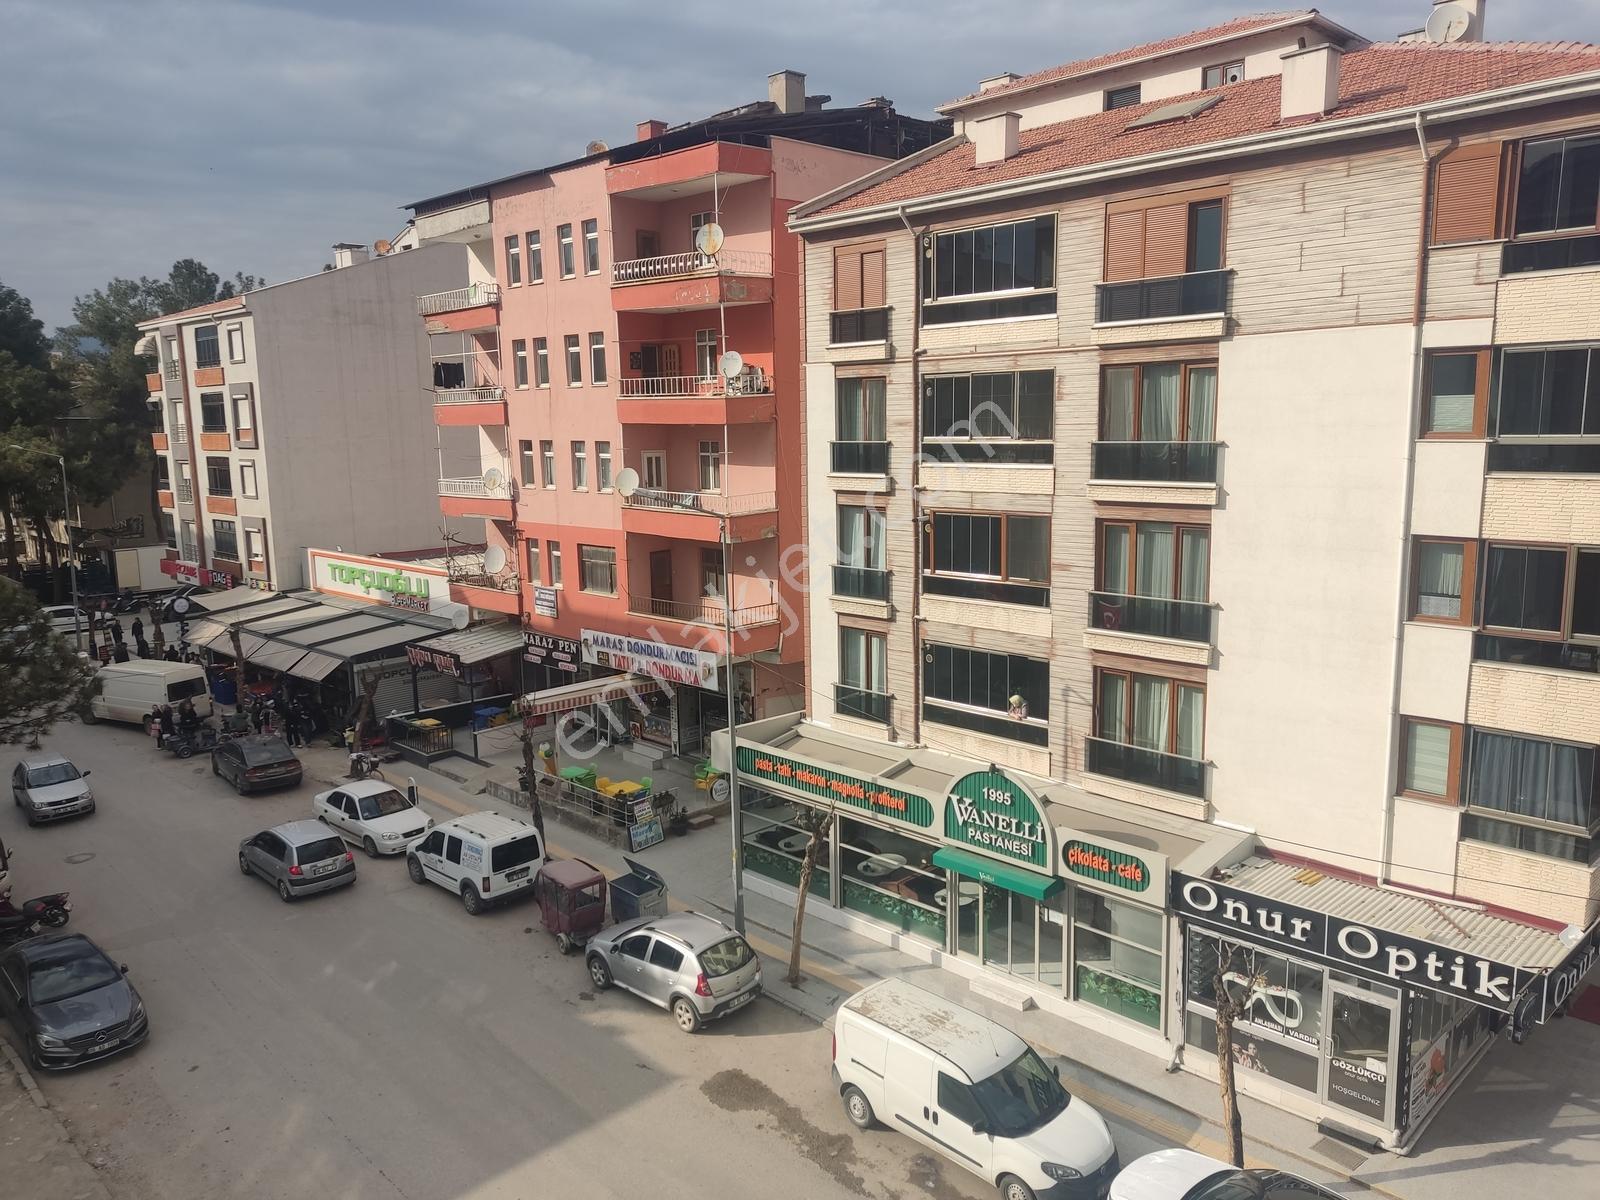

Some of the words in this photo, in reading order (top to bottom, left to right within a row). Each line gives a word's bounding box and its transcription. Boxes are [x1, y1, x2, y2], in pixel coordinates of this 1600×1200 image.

[559, 640, 577, 654] PEN
[755, 758, 773, 772] pasta
[796, 769, 826, 787] makaron
[831, 779, 864, 799] magnolia
[871, 789, 906, 811] profiterol
[982, 787, 1011, 805] 1995
[968, 828, 1032, 856] PASTANESİ
[1068, 847, 1109, 873] çikolata
[1118, 862, 1143, 882] cafe
[1183, 881, 1313, 942] Onur
[1337, 925, 1510, 1002] Optik
[1288, 1029, 1318, 1045] VARDIR
